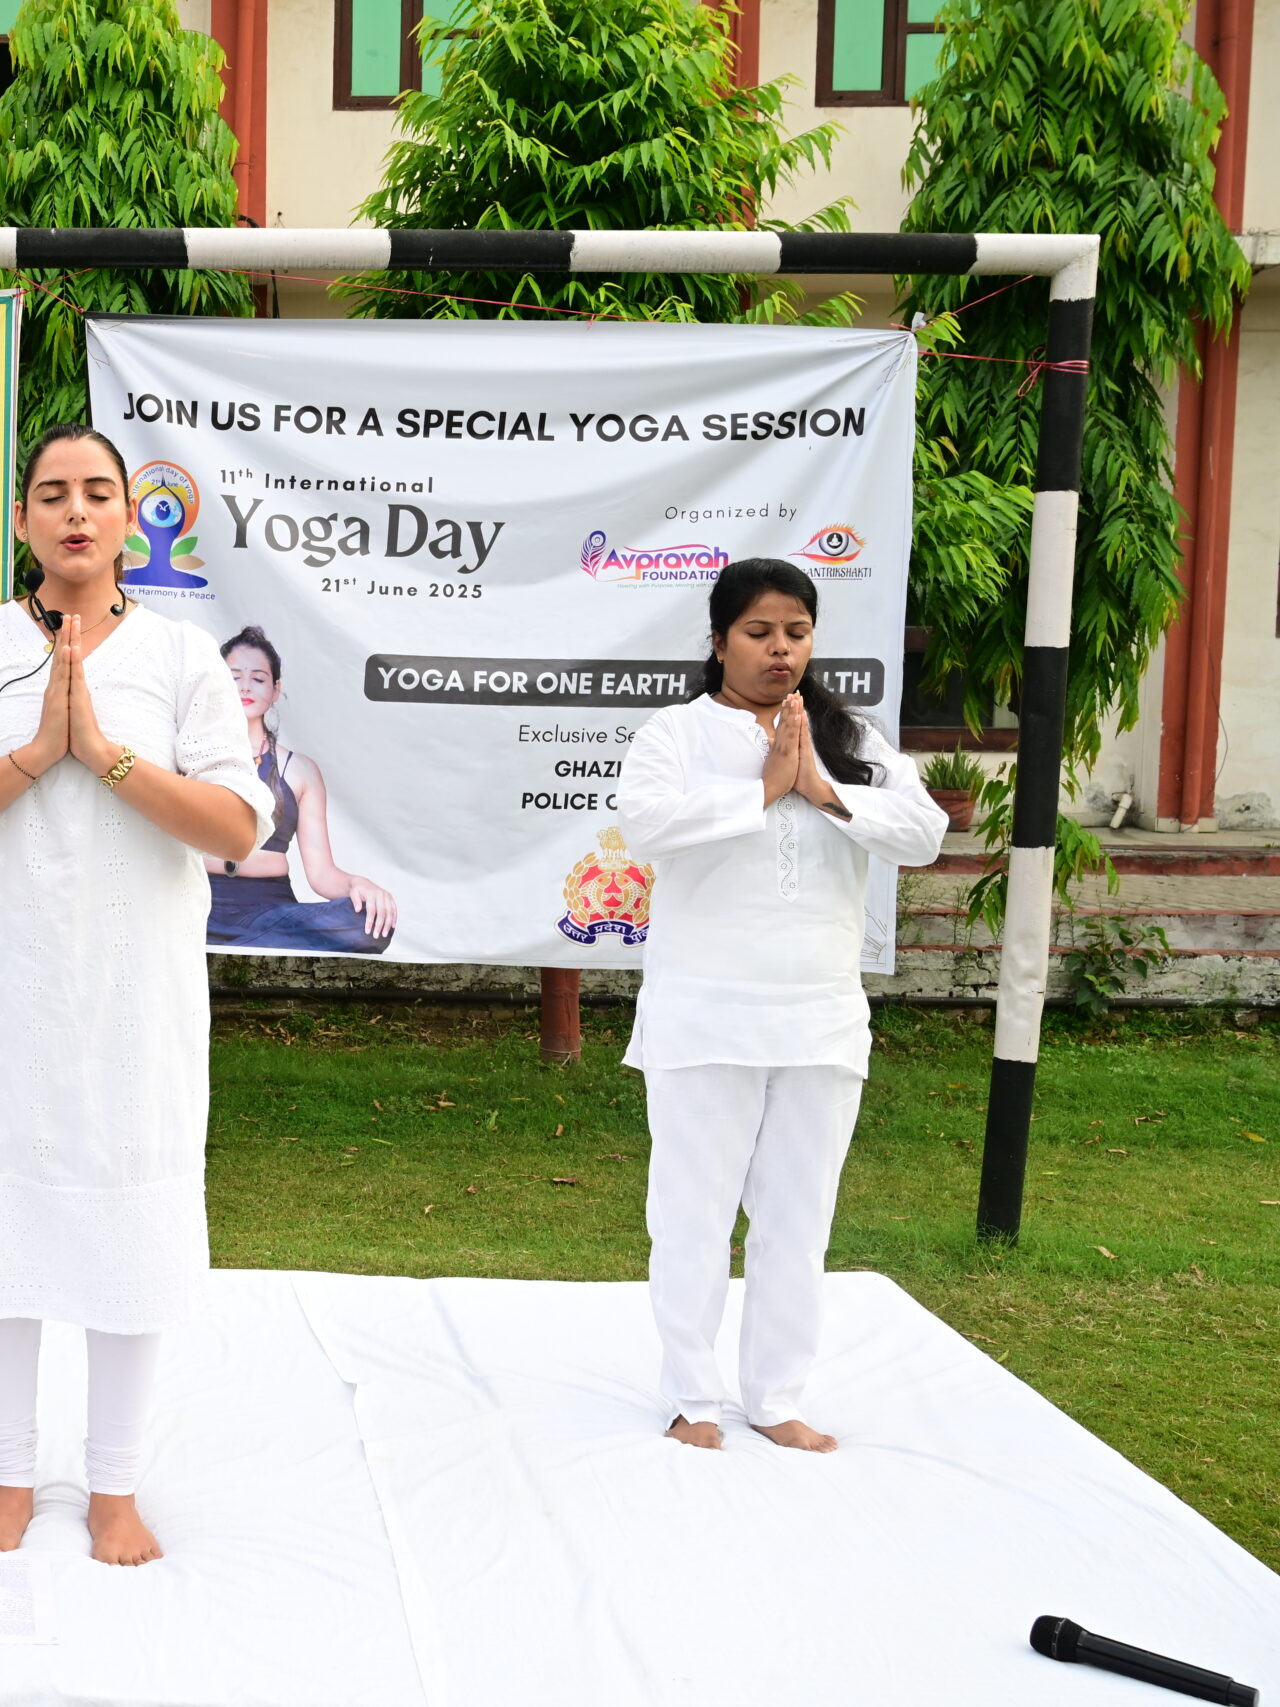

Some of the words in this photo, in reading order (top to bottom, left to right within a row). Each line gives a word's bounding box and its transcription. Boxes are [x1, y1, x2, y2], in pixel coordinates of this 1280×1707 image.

[123, 392, 198, 429] JOIN
[210, 401, 261, 432] US
[273, 404, 347, 436] FOR
[356, 407, 384, 437] A
[395, 407, 555, 442] SPECIAL
[568, 412, 690, 443] YOGA
[702, 407, 866, 442] SESSION
[165, 467, 179, 477] day
[179, 475, 188, 484] of
[185, 484, 194, 504] yoga
[220, 468, 254, 485] 11th
[265, 473, 434, 493] International
[665, 503, 769, 523] Organized
[778, 503, 798, 522] by
[220, 494, 371, 568] Yoga
[384, 503, 506, 574] Day
[601, 547, 729, 579] Avpravah
[801, 567, 872, 578] ANTRIKSHAKTI
[642, 570, 721, 581] FOUNDATIO
[123, 587, 136, 595] for
[138, 588, 178, 598] Harmony
[189, 591, 216, 600] Peace
[321, 577, 357, 593] 21st
[367, 580, 418, 597] June
[428, 583, 483, 599] 2025
[377, 666, 465, 692] YOGA
[473, 670, 528, 694] FOR
[536, 671, 593, 695] ONE
[601, 673, 687, 696] EARTH
[823, 671, 871, 694] LTH
[518, 724, 608, 744] Exclusive
[554, 760, 622, 778] GHAZI
[521, 792, 598, 810] POLICE
[563, 922, 588, 942] उत्तर
[594, 921, 627, 934] प्रदेश
